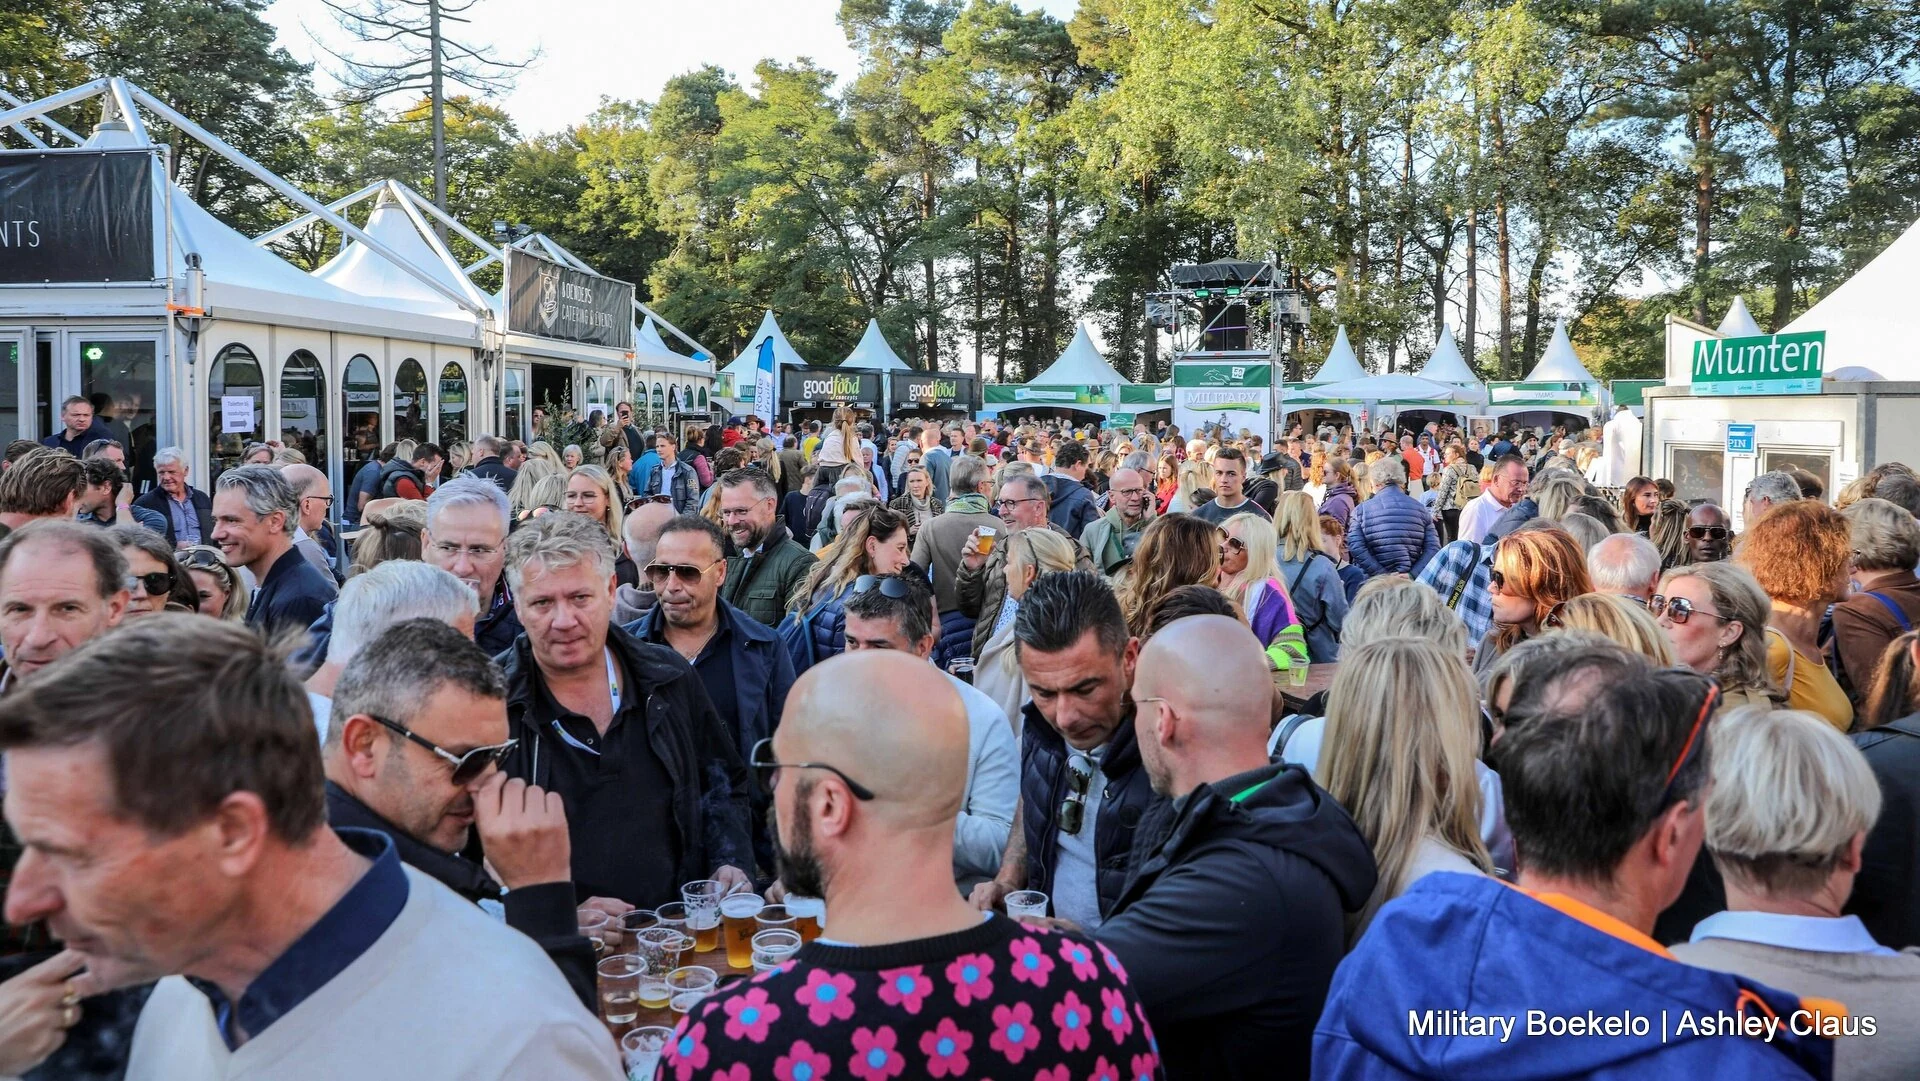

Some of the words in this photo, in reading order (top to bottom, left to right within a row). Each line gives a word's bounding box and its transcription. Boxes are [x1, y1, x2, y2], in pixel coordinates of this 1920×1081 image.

[1694, 334, 1823, 376] Munten
[755, 377, 764, 412] Rode
[1188, 392, 1257, 404] MILITARY
[1728, 438, 1747, 448] PIN
